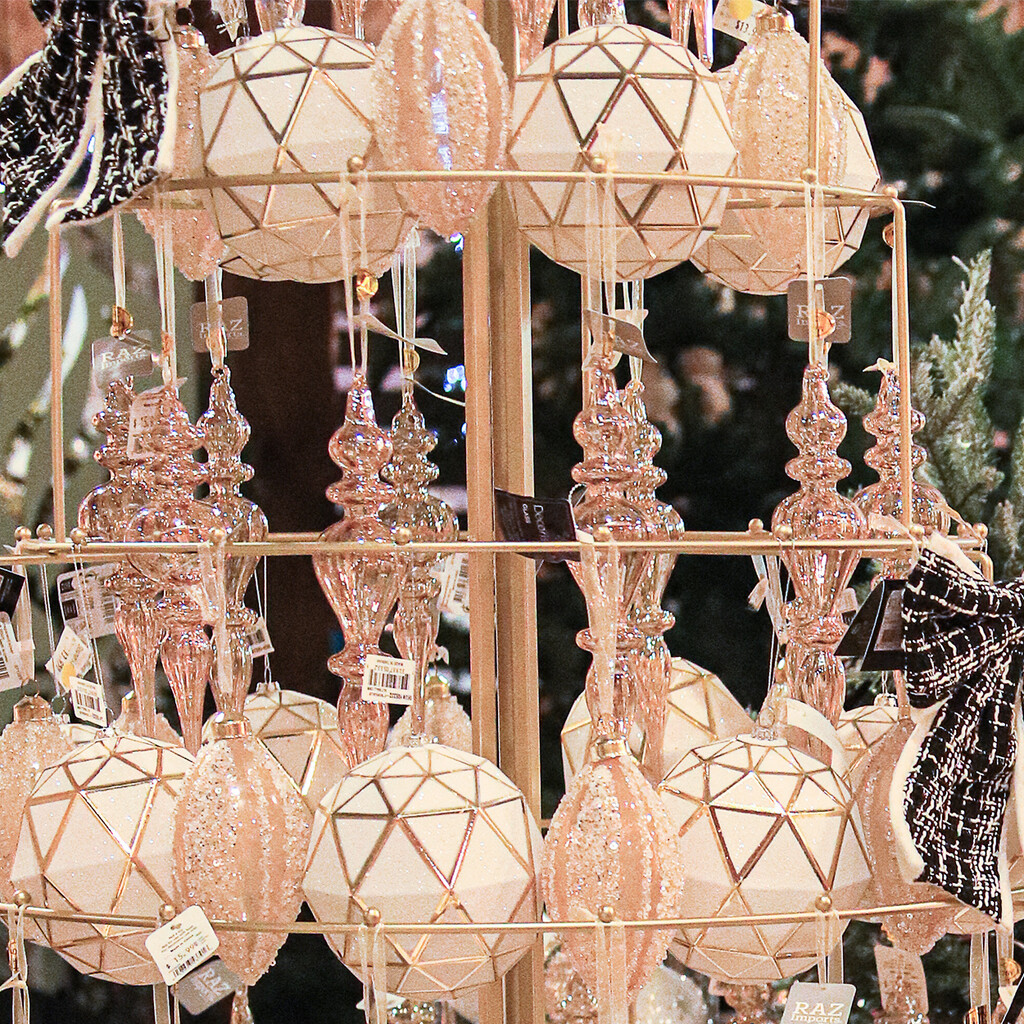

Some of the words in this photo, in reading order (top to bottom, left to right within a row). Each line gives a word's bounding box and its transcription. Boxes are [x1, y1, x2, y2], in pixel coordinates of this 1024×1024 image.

[796, 304, 845, 319] RZ
[102, 344, 147, 362] RAZ
[198, 967, 232, 997] RAZ
[792, 1001, 845, 1017] RAZ
